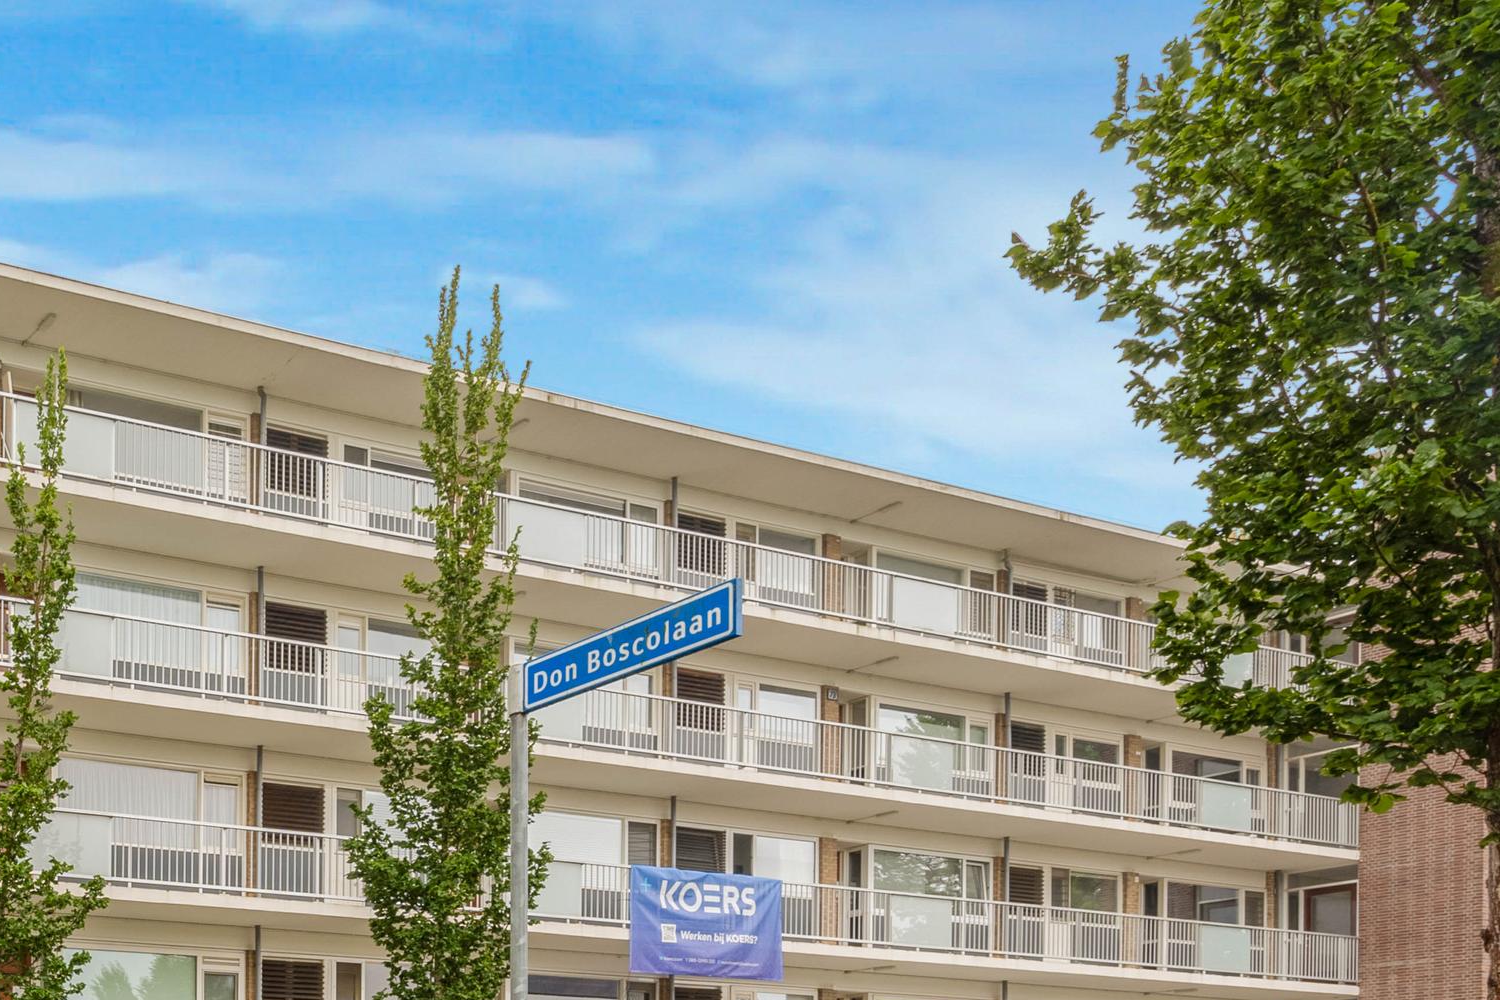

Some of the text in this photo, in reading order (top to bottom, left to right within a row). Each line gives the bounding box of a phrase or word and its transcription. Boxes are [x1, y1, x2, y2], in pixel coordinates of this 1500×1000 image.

[533, 606, 722, 694] Don Boscolaan
[660, 879, 756, 916] KOERS
[680, 930, 758, 945] Werken bij KOERS?
